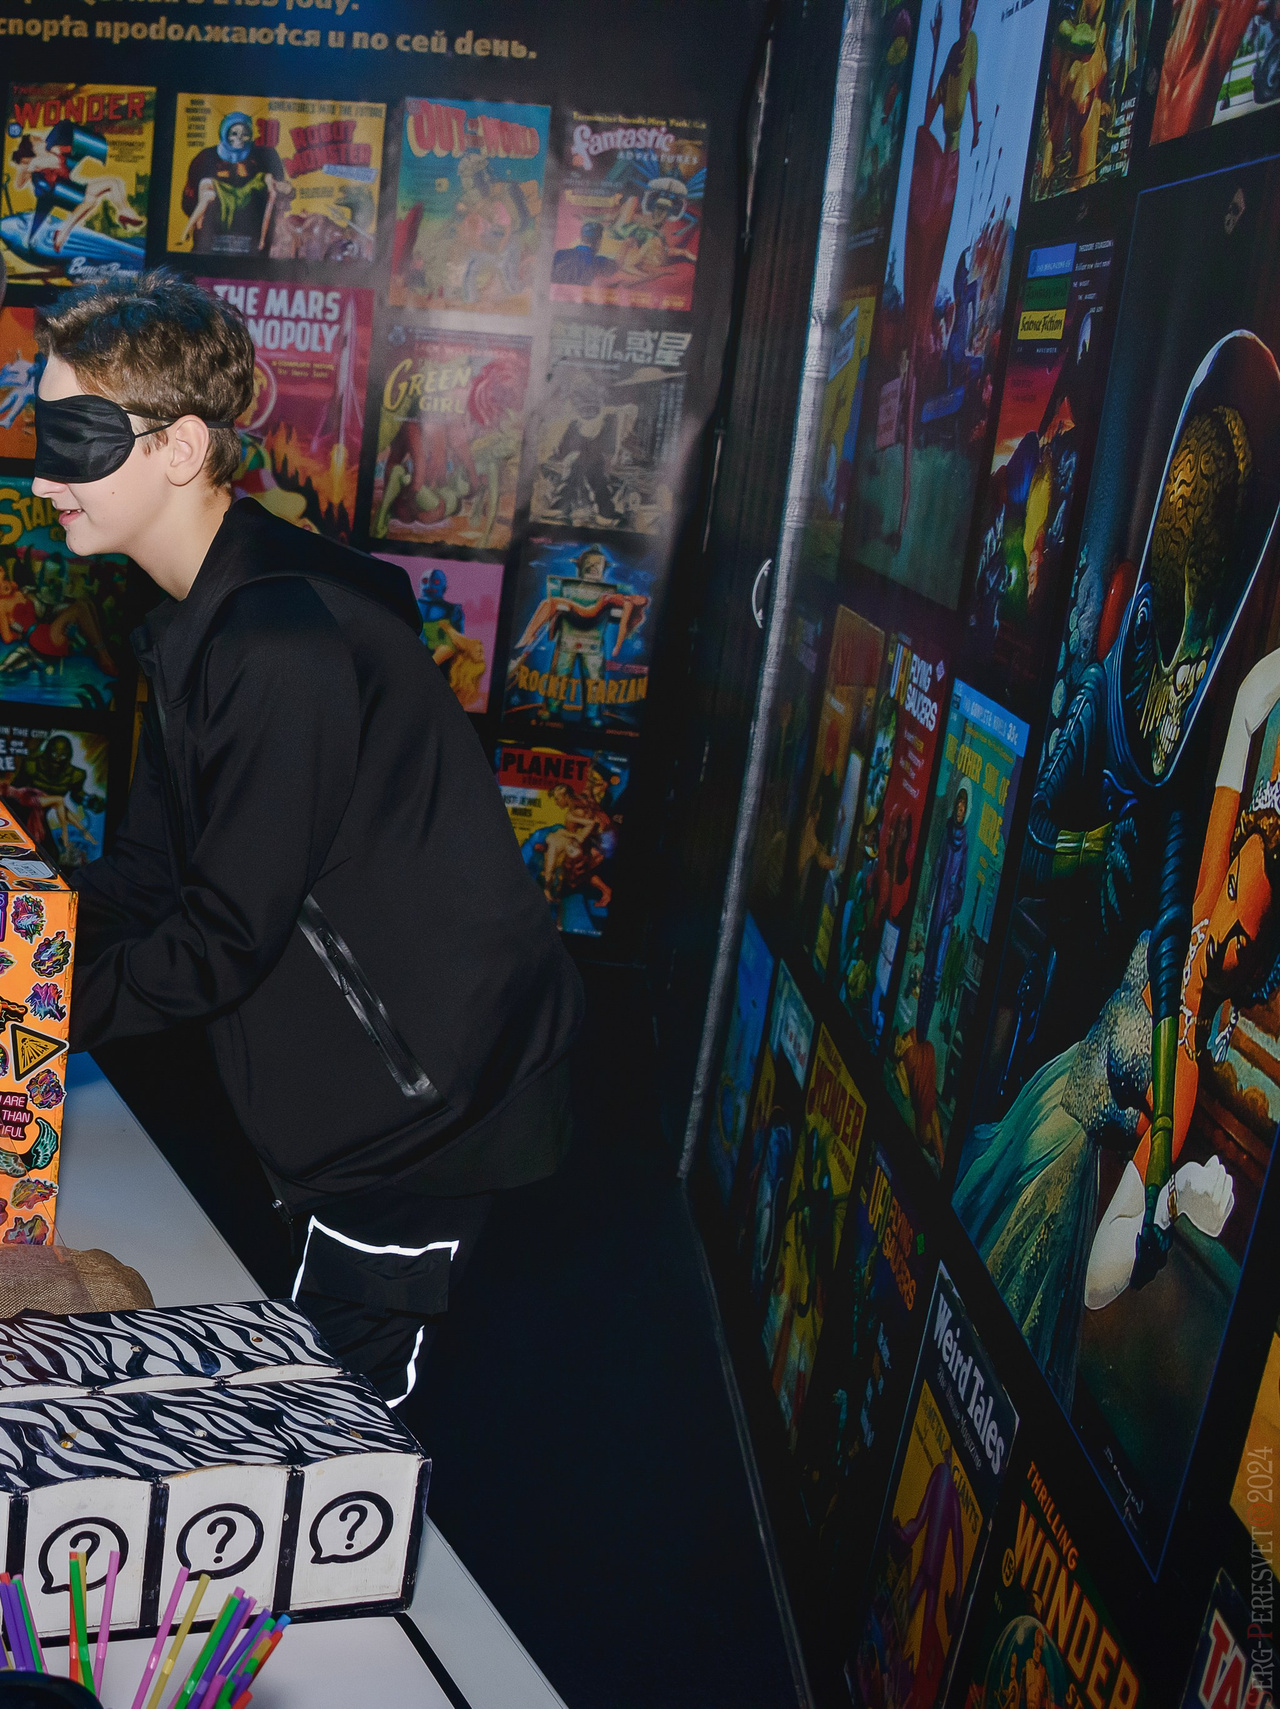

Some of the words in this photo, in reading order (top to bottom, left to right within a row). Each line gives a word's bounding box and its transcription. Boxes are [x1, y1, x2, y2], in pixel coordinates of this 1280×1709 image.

[95, 16, 321, 47] продолжаются
[327, 31, 346, 48] и
[352, 31, 389, 50] по
[396, 31, 448, 53] сей
[455, 32, 538, 59] день.
[14, 92, 146, 128] WONDER
[263, 288, 342, 322] MARS
[1020, 315, 1041, 332] Science
[1041, 313, 1063, 333] Fiction
[247, 317, 341, 353] NOPOLY
[518, 664, 581, 702] ROCKET
[910, 653, 933, 693] FLYING
[904, 683, 938, 732] SAUCERS
[502, 753, 588, 781] PLANET
[957, 743, 983, 784] OTHER
[2, 1109, 31, 1124] THAN
[3, 1094, 26, 1107] ARE
[882, 1226, 917, 1311] SAUCERS
[934, 1292, 973, 1401] Weird
[967, 1366, 1005, 1475] Tales
[952, 1464, 979, 1535] GIANTS
[1026, 1460, 1080, 1571] THRILLING
[1013, 1500, 1140, 1709] WONDER
